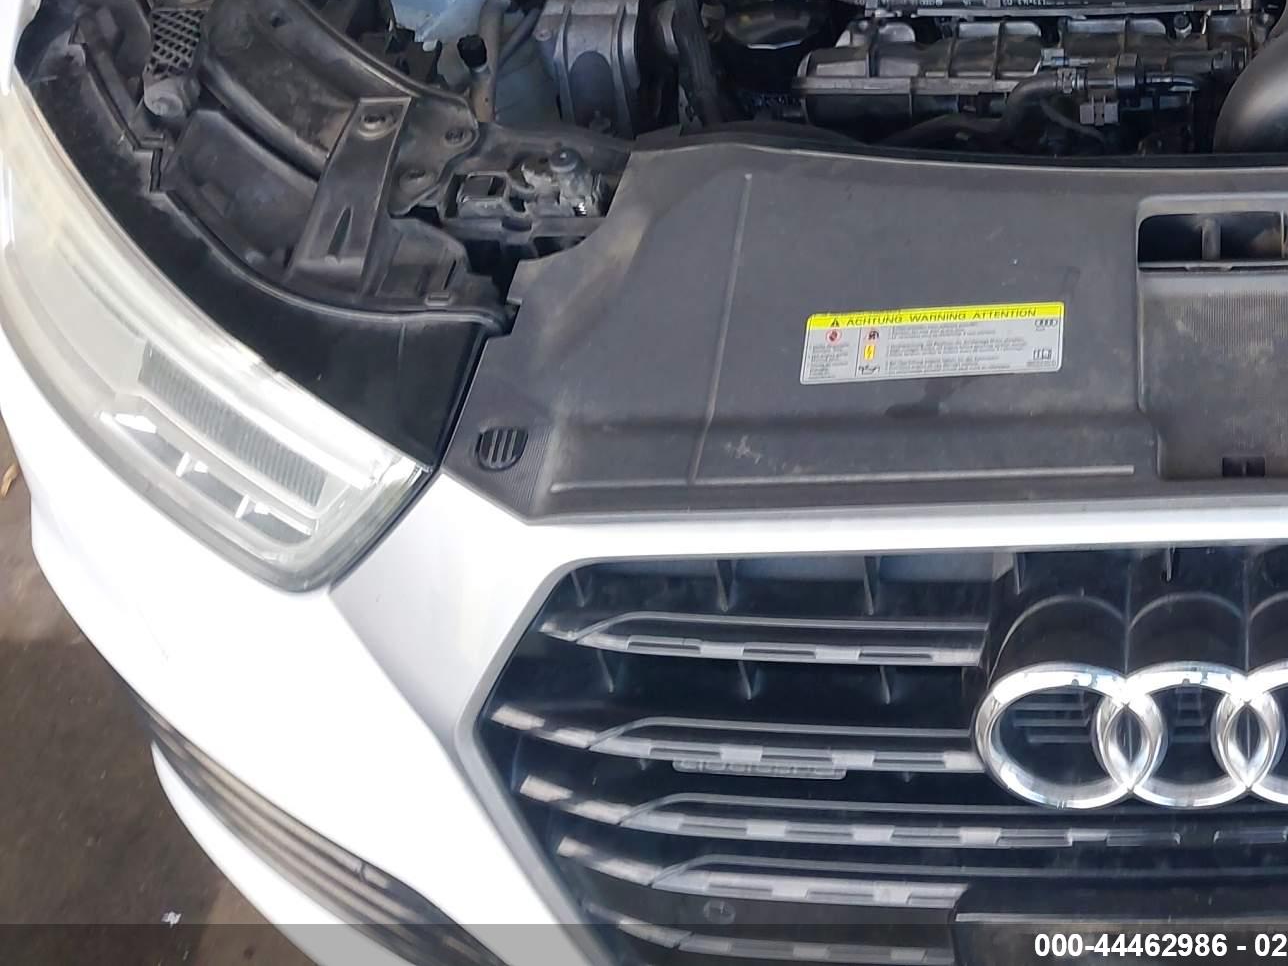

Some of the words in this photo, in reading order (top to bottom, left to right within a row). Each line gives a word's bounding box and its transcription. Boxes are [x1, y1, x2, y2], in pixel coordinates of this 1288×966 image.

[846, 315, 903, 327] ACHTUNG
[909, 312, 967, 324] WARNING
[973, 308, 1037, 320] ATTENTION
